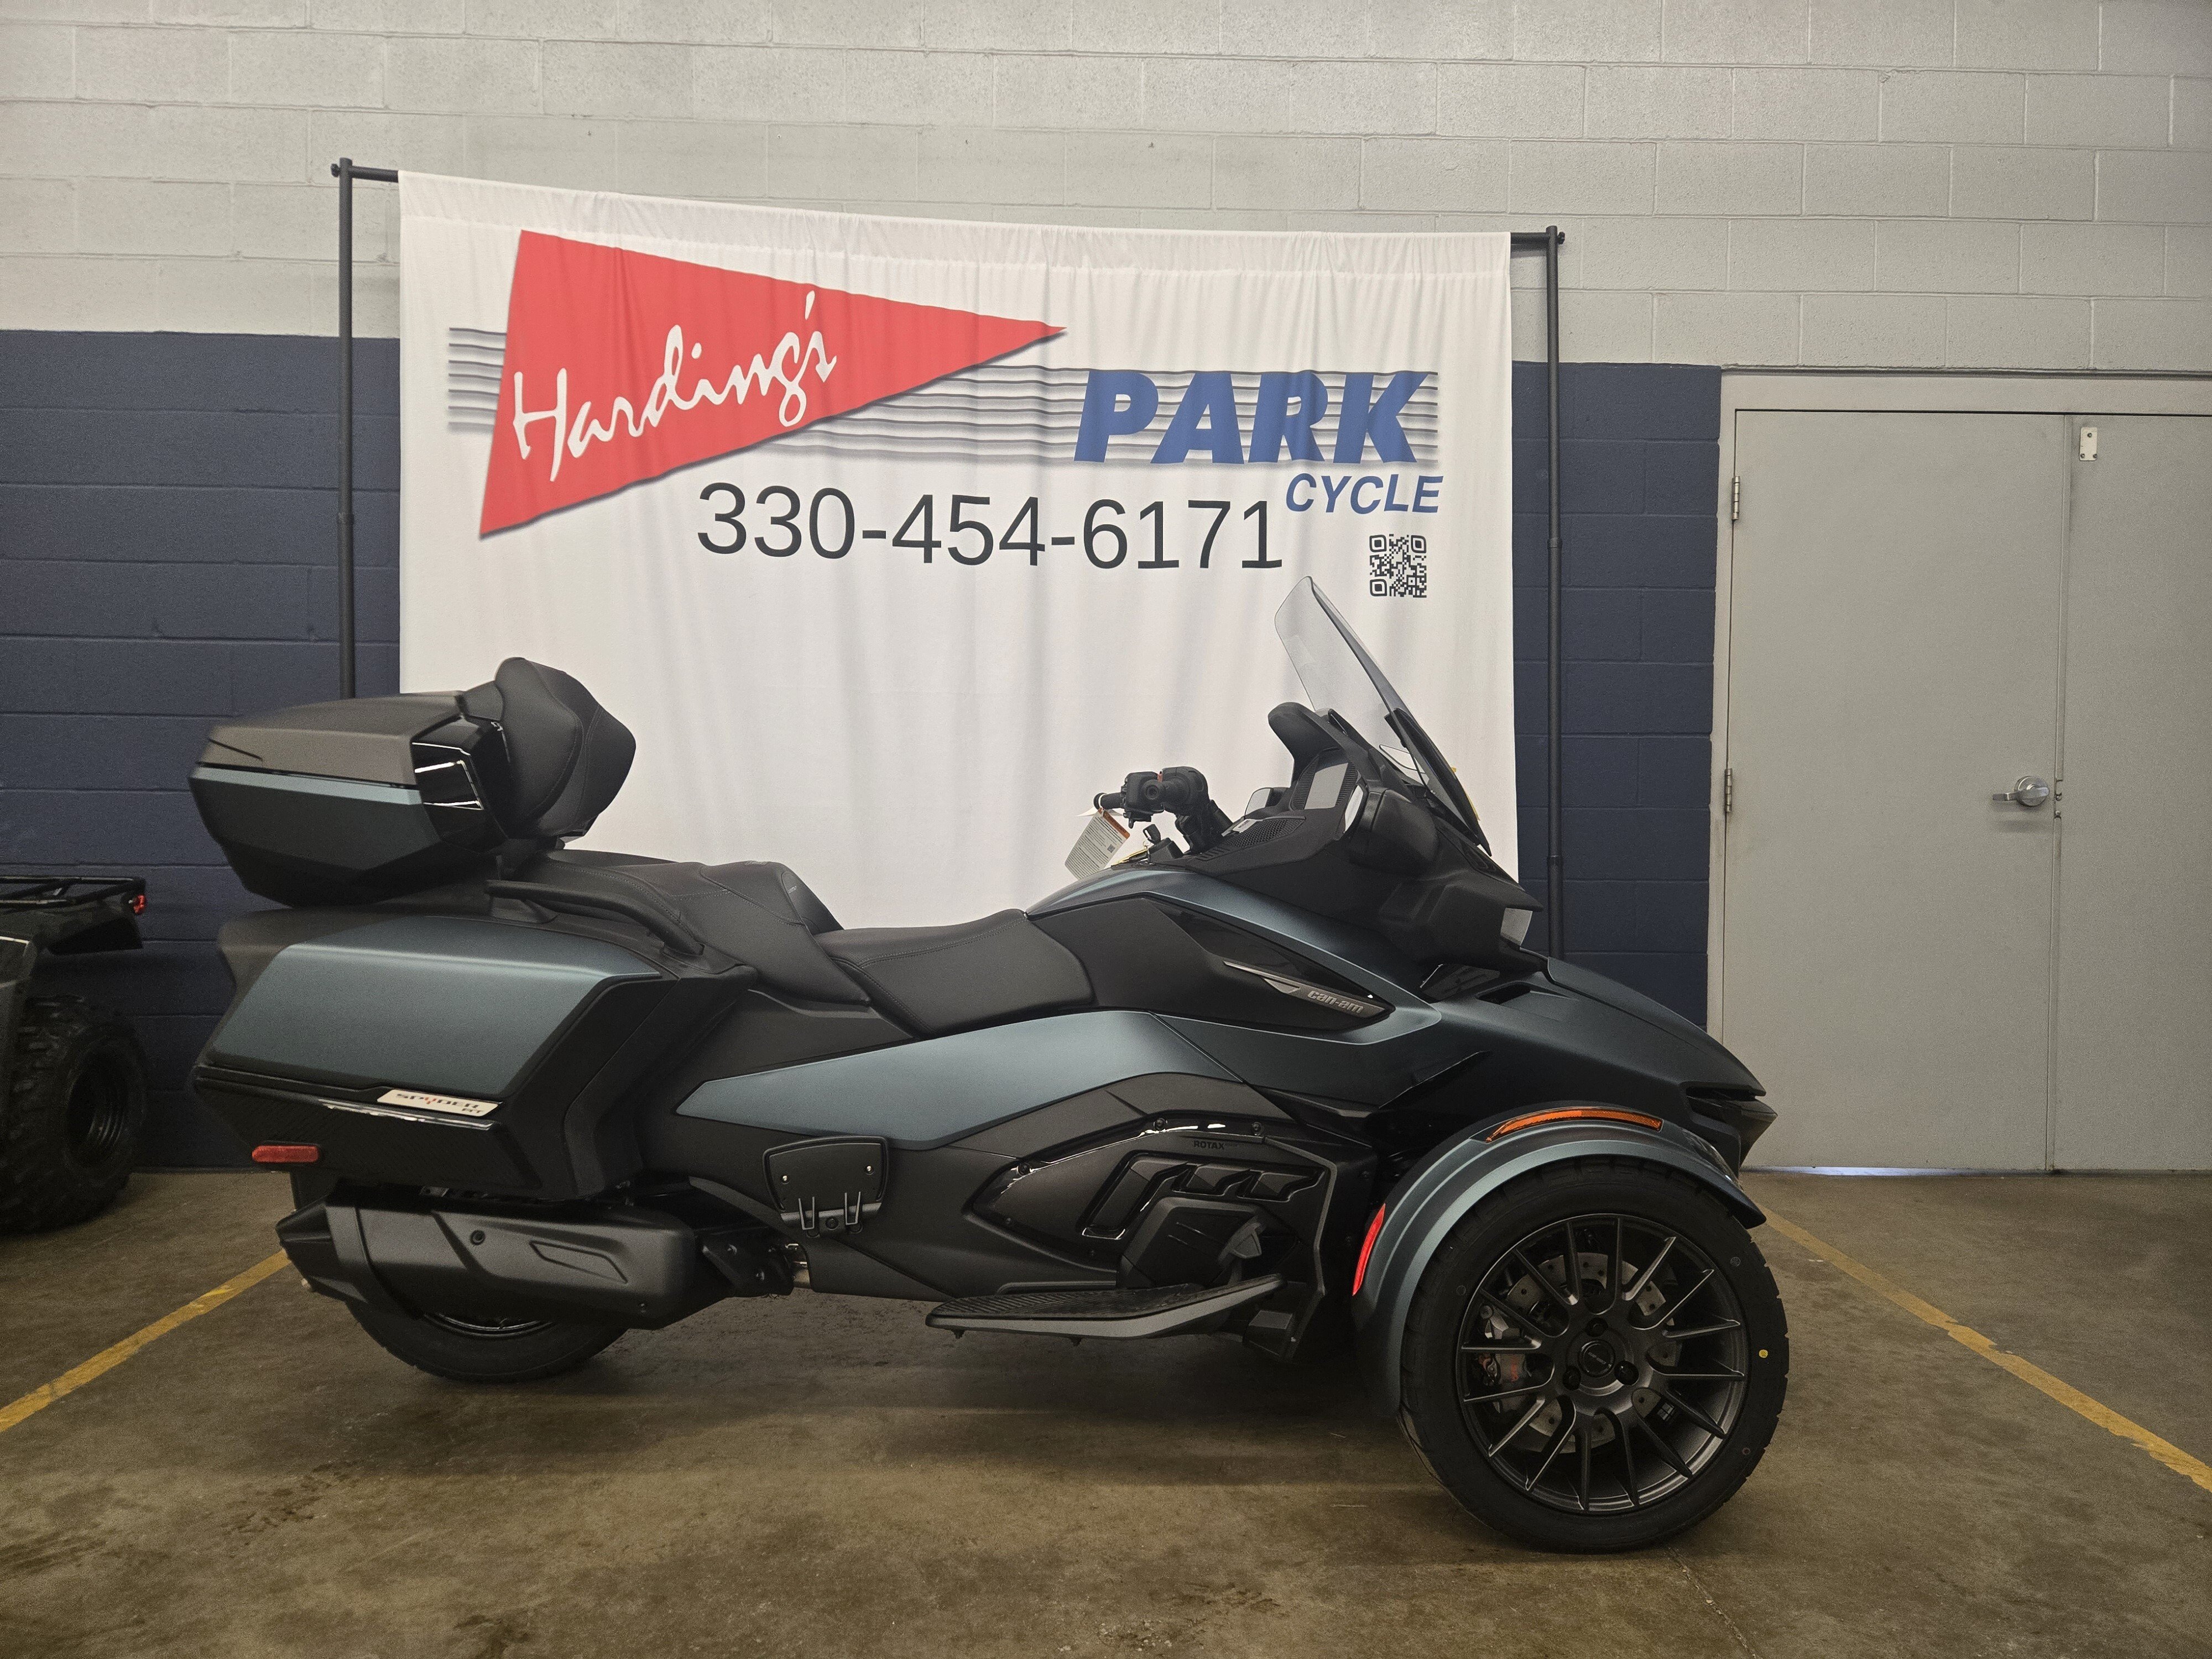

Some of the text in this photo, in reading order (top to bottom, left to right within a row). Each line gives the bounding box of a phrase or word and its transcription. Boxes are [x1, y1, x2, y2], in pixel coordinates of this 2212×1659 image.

[513, 290, 838, 482] Harding's
[1073, 369, 1429, 465] PARK
[1286, 473, 1444, 514] CYCLE
[697, 482, 1283, 570] 330-454-6171
[1307, 990, 1364, 1014] can-am
[395, 1093, 479, 1109] SPYDER
[1193, 1140, 1225, 1150] ROTAX
